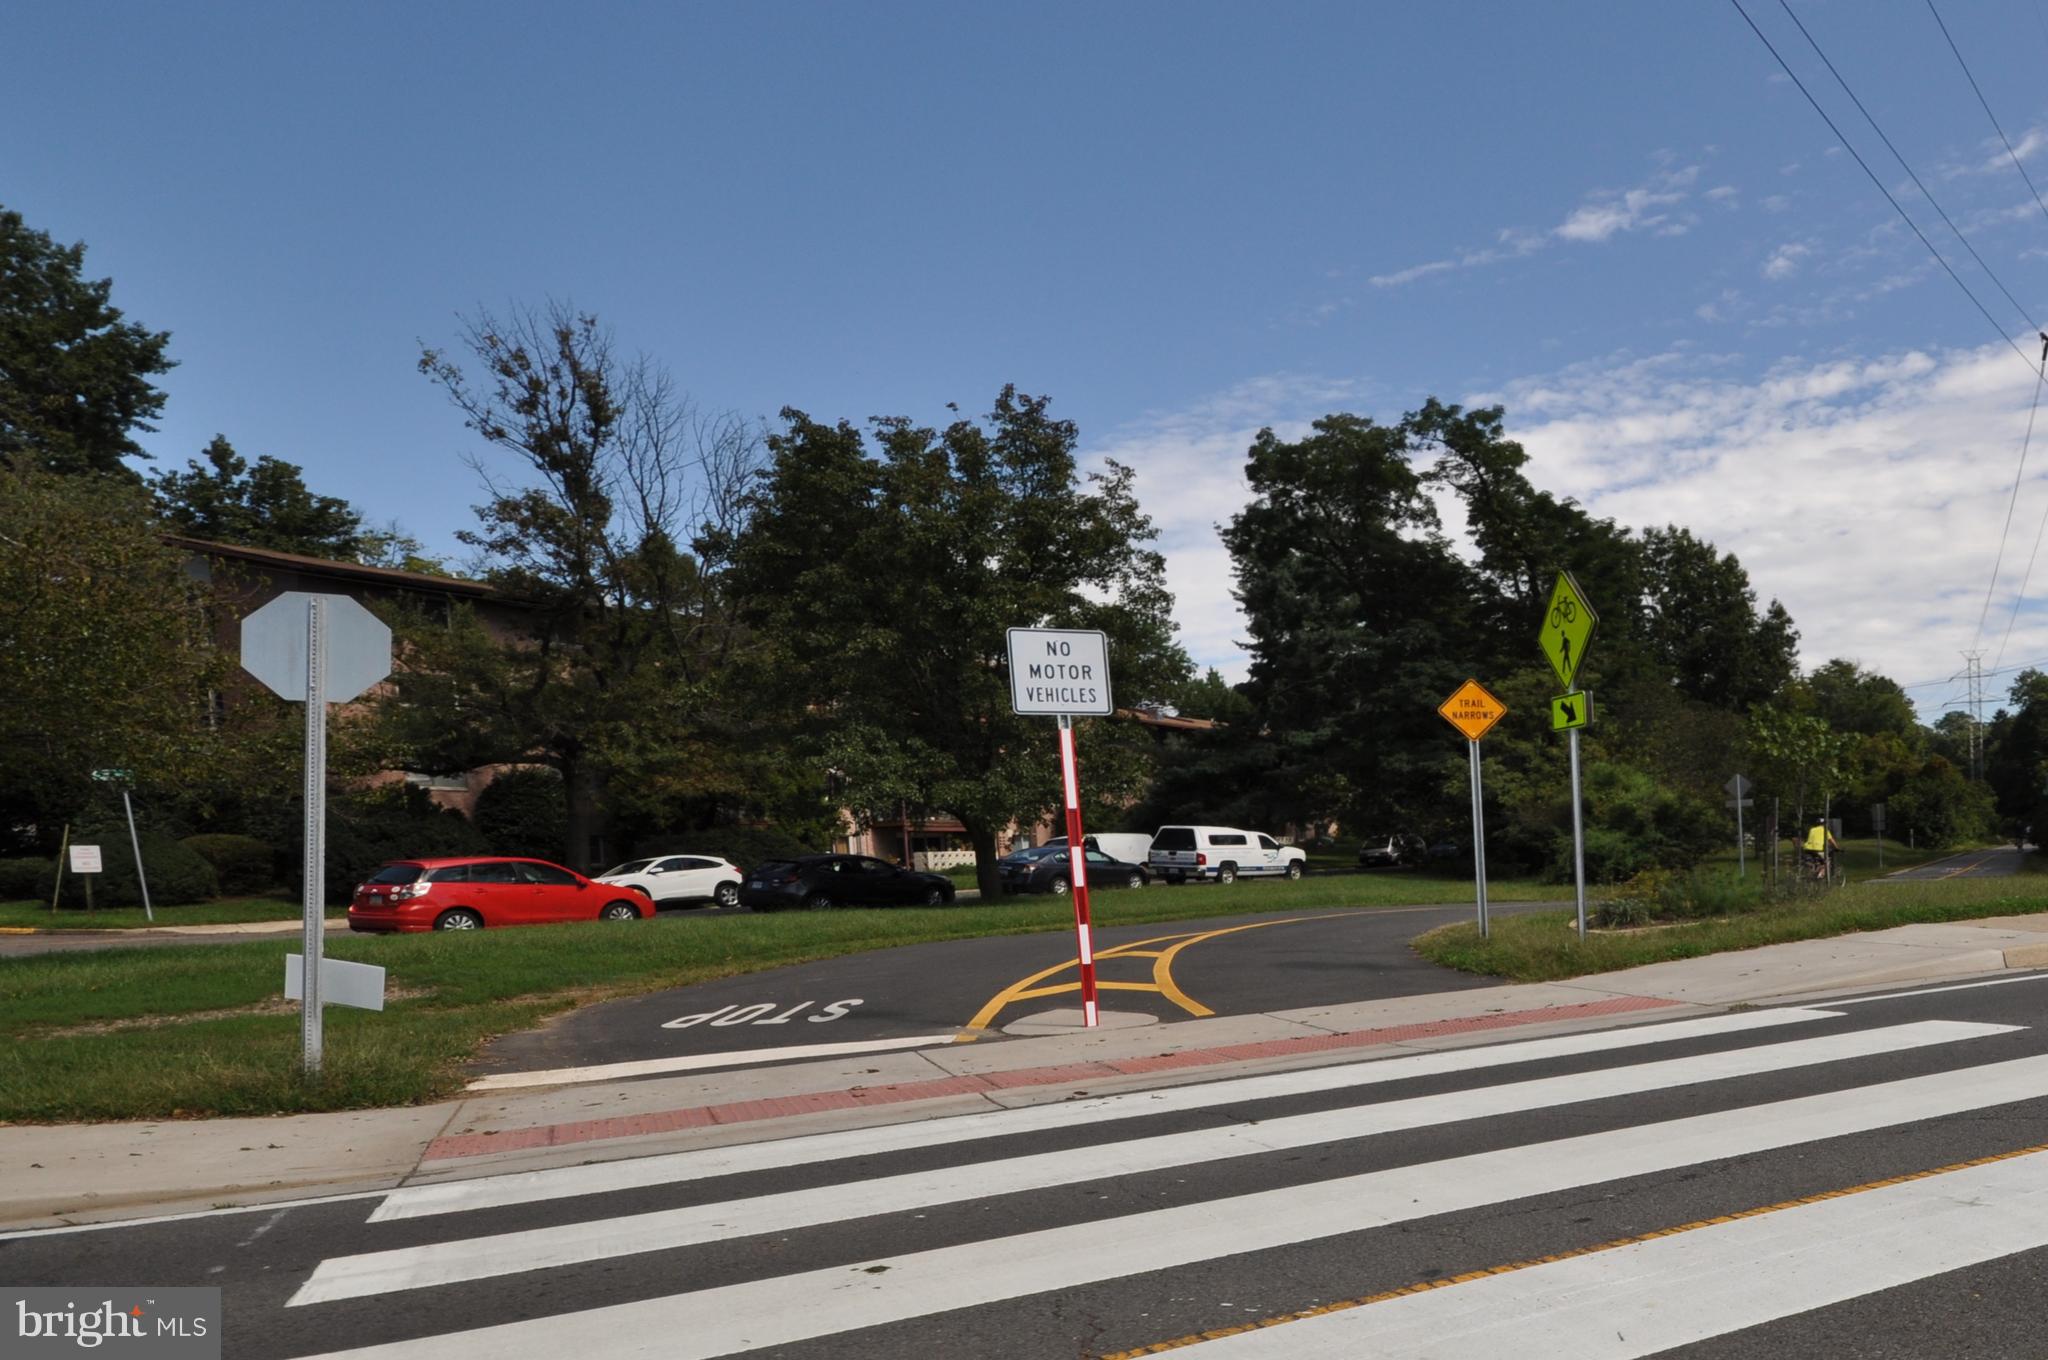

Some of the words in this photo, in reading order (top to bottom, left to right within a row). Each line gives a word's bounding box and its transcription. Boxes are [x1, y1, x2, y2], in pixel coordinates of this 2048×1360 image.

[1046, 641, 1071, 656] NO
[1029, 664, 1092, 680] MOTOR
[1026, 687, 1097, 703] VEHICLES
[1459, 699, 1485, 709] TRAIL
[1452, 711, 1495, 720] NARROWS
[660, 998, 864, 1029] STOP
